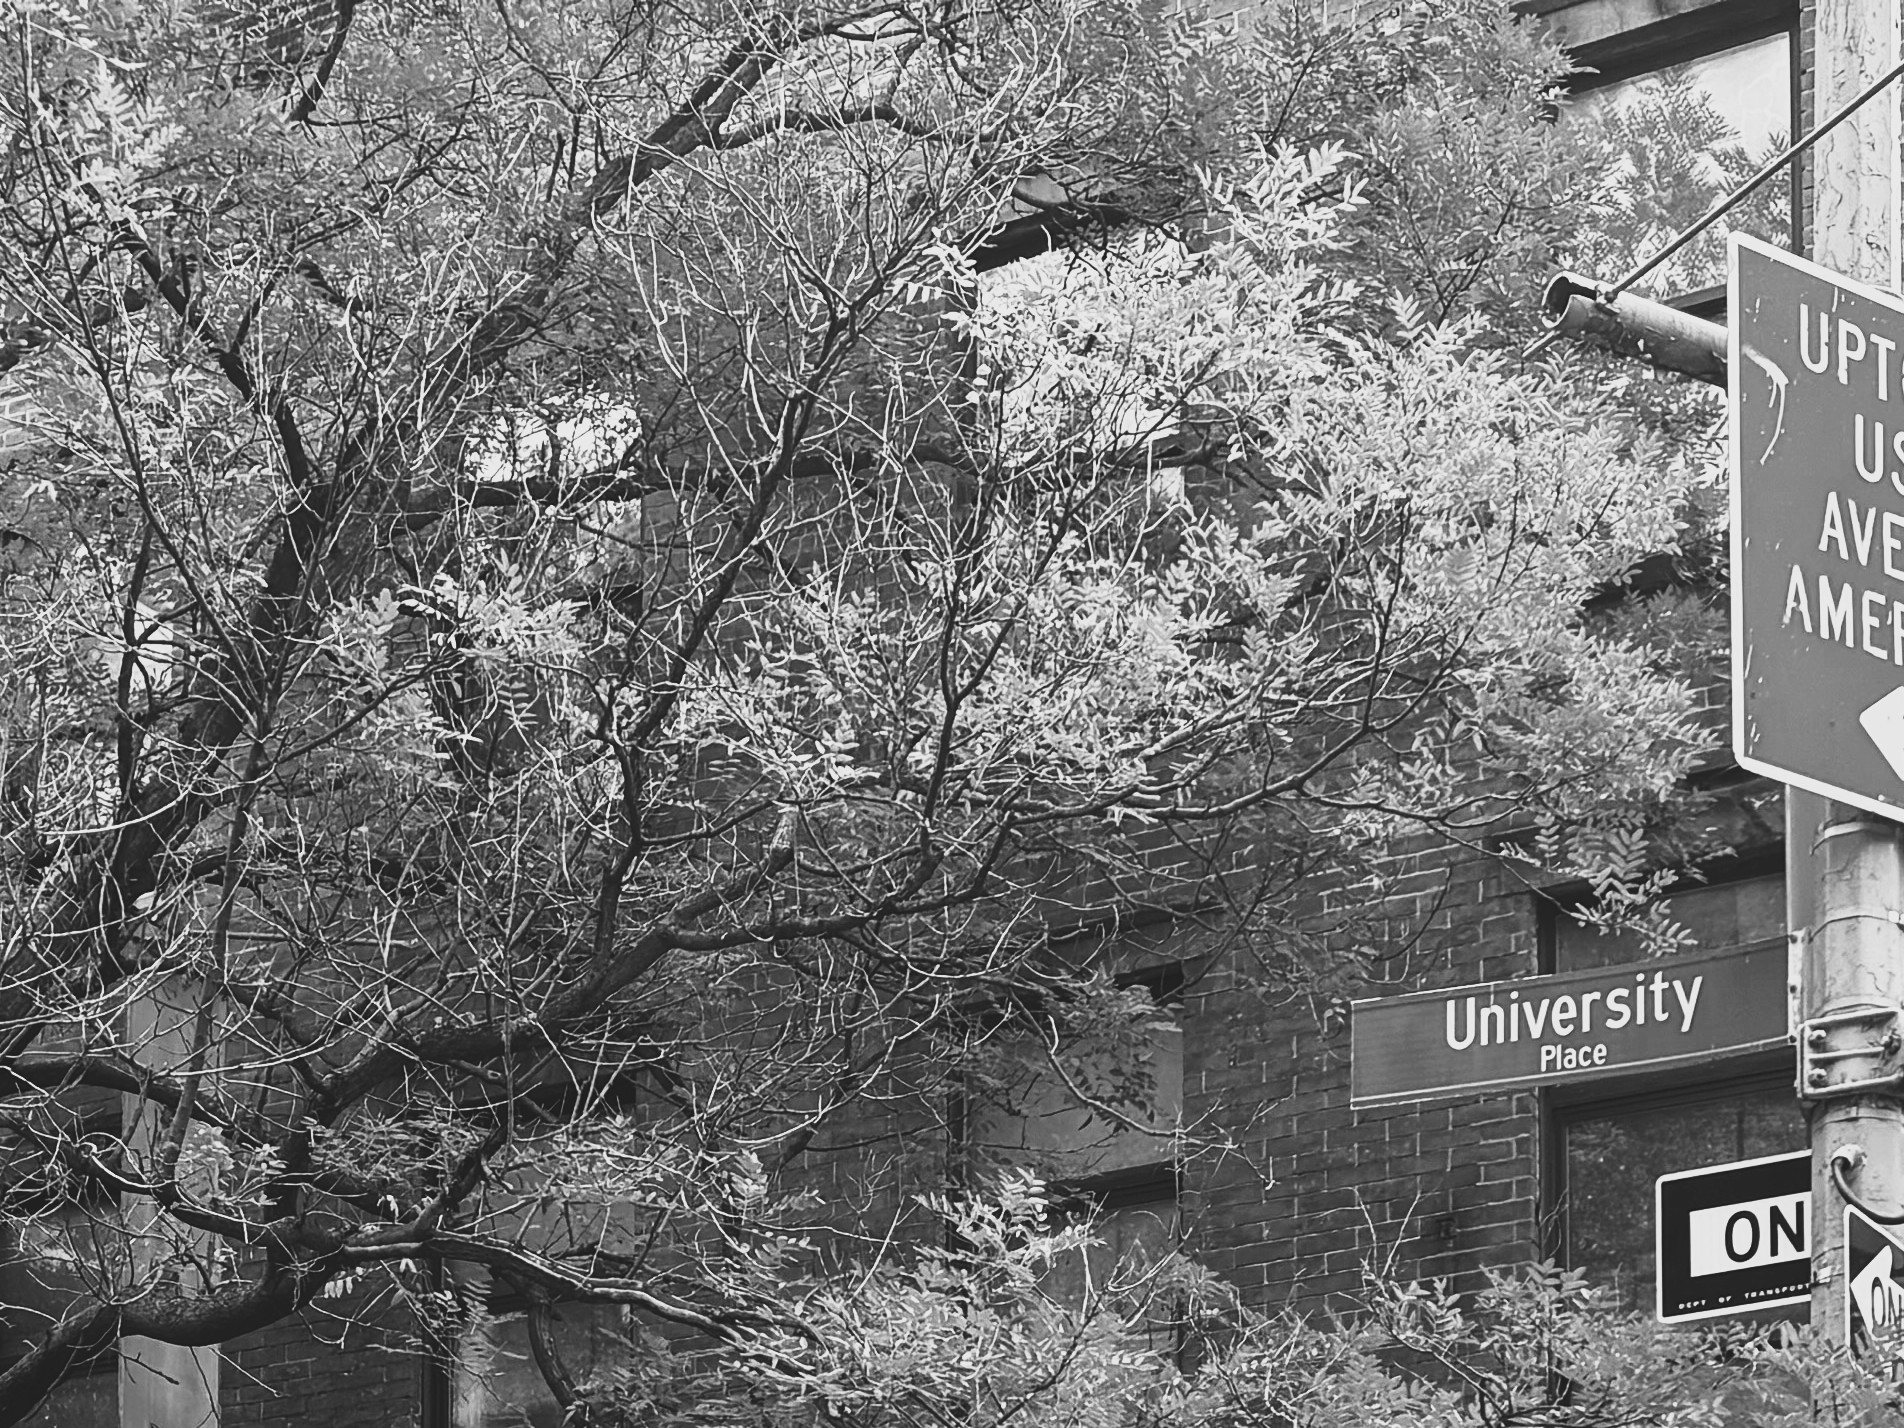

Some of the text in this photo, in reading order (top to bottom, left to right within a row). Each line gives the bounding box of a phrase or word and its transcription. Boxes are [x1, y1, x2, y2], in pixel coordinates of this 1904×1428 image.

[1445, 970, 1704, 1051] University
[1540, 1043, 1608, 1073] Place
[1724, 1200, 1806, 1263] ON
